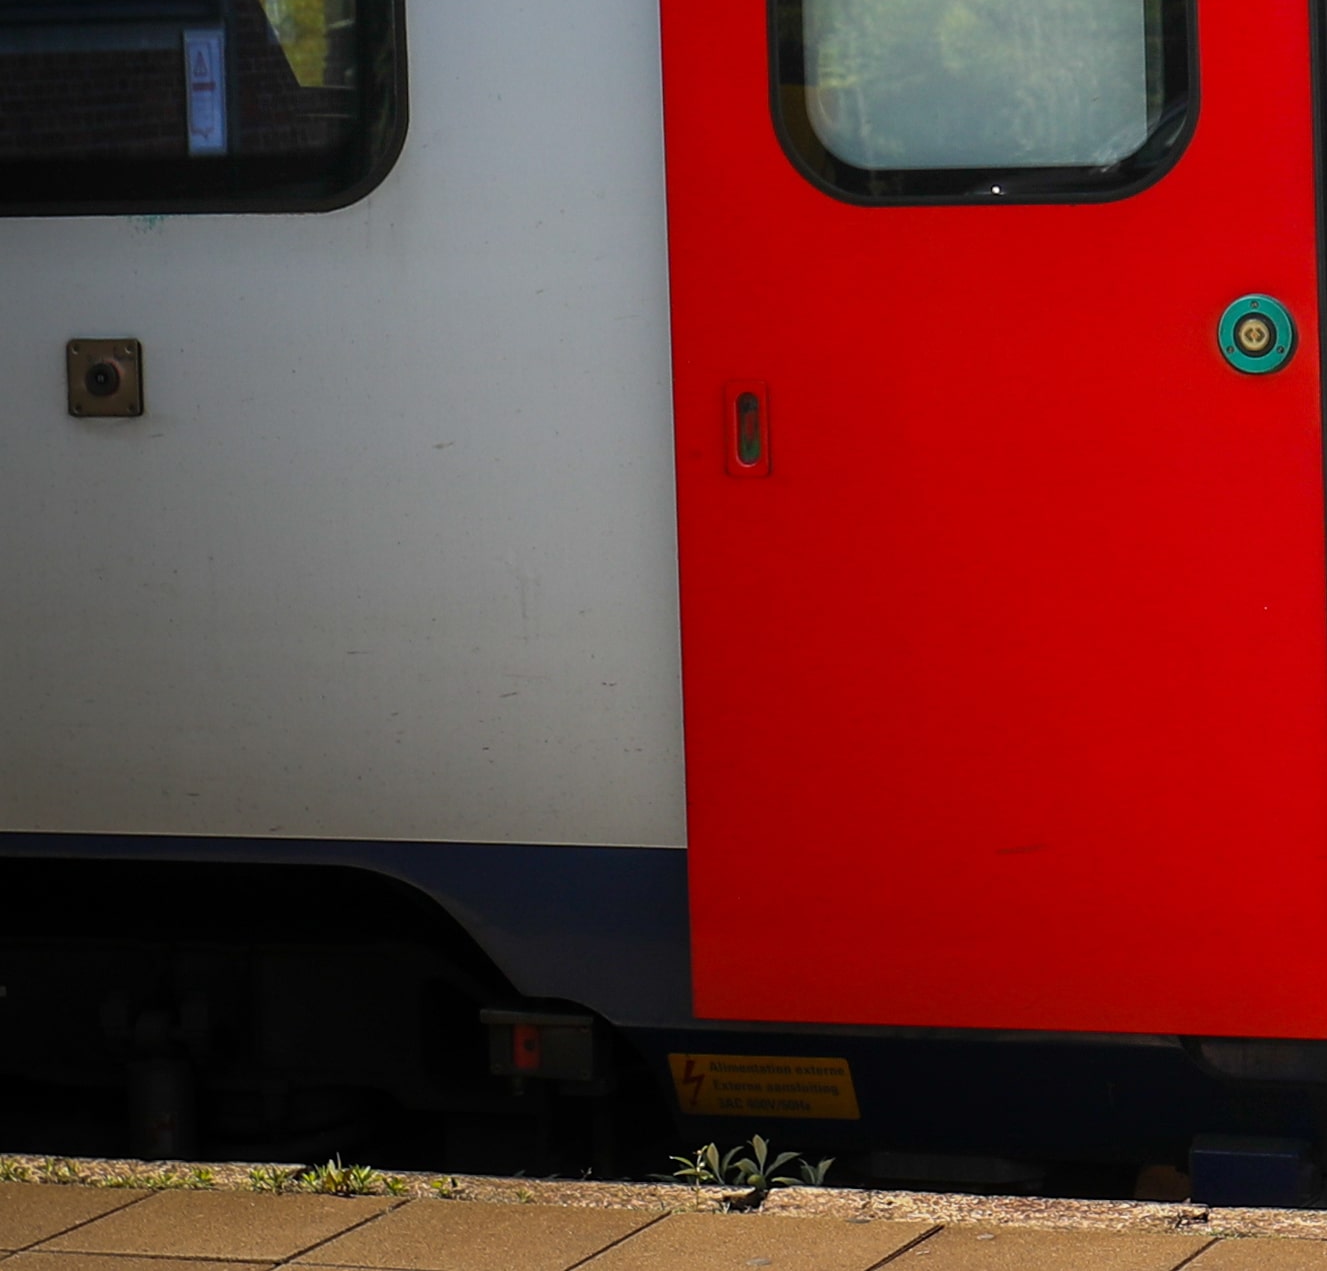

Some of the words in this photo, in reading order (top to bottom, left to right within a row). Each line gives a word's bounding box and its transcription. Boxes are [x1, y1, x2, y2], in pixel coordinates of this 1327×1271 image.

[709, 1060, 792, 1075] Alimentation
[795, 1065, 845, 1076] externe
[712, 1080, 762, 1092] Externe
